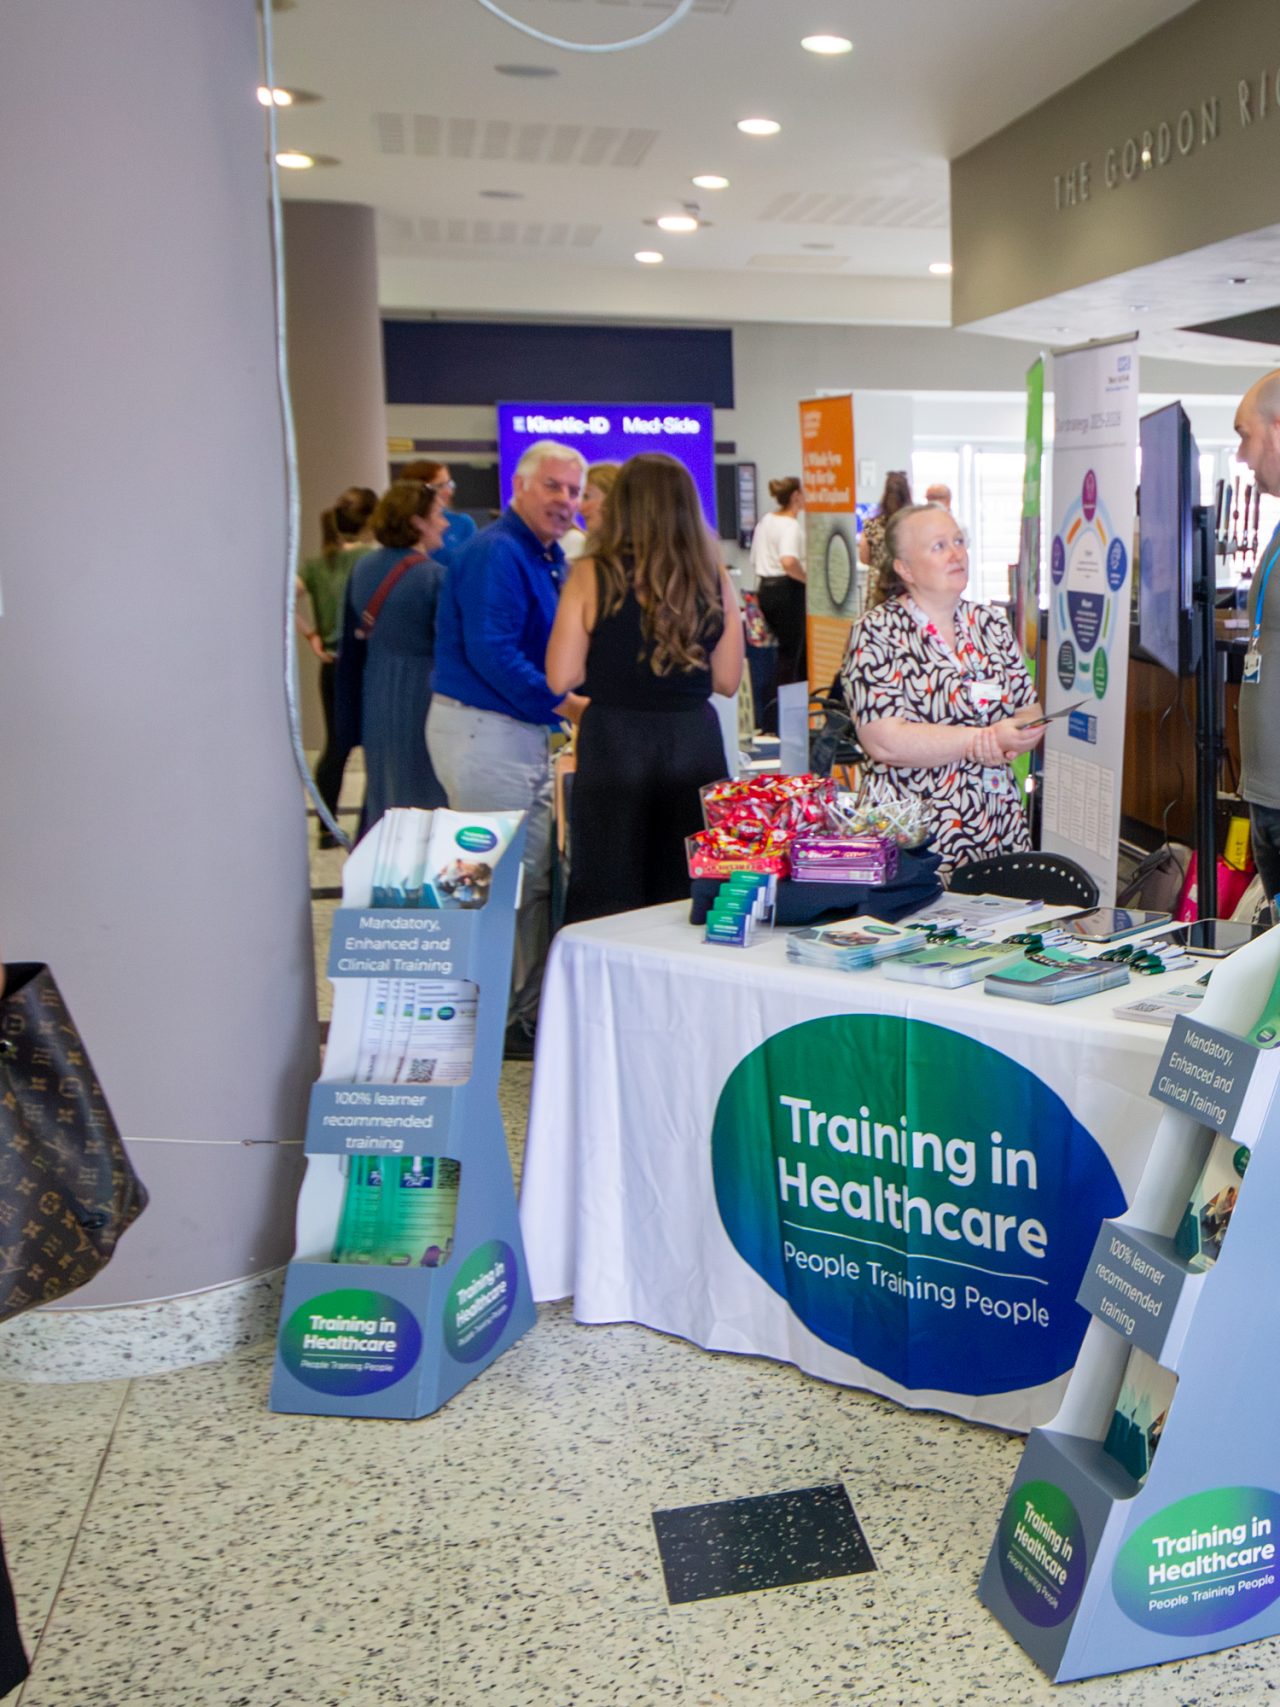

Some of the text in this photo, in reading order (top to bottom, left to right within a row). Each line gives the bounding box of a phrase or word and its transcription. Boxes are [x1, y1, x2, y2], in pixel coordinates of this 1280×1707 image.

[1053, 161, 1090, 210] THE
[1105, 97, 1220, 189] GORDON
[527, 415, 700, 435] Kinetic-ID Med-Side
[344, 936, 451, 951] Enhanced and
[359, 916, 440, 932] Mandatory,
[337, 957, 453, 975] Clinical Training
[1185, 1029, 1233, 1065] Mandatory,
[1169, 1052, 1233, 1094] Enhanced and
[335, 1091, 427, 1106] 100% learner
[1158, 1075, 1227, 1124] Clinical Training
[323, 1114, 433, 1128] recommended
[345, 1135, 404, 1153] training
[780, 1095, 1037, 1190] Training in
[778, 1156, 1049, 1258] Healthcare
[1108, 1236, 1165, 1286] 100% learner
[456, 1262, 504, 1305] Training in
[456, 1281, 507, 1328] Healthcare
[784, 1241, 1049, 1327] People Training People
[1096, 1263, 1162, 1317] recommended
[309, 1314, 396, 1335] Training in
[1101, 1297, 1136, 1336] training
[303, 1333, 397, 1352] Healthcare
[1024, 1501, 1073, 1562] Training in
[1152, 1516, 1271, 1558] Training in
[1014, 1521, 1067, 1585] Healthcare
[1148, 1540, 1275, 1585] Healthcare
[1149, 1573, 1274, 1611] People Training People
